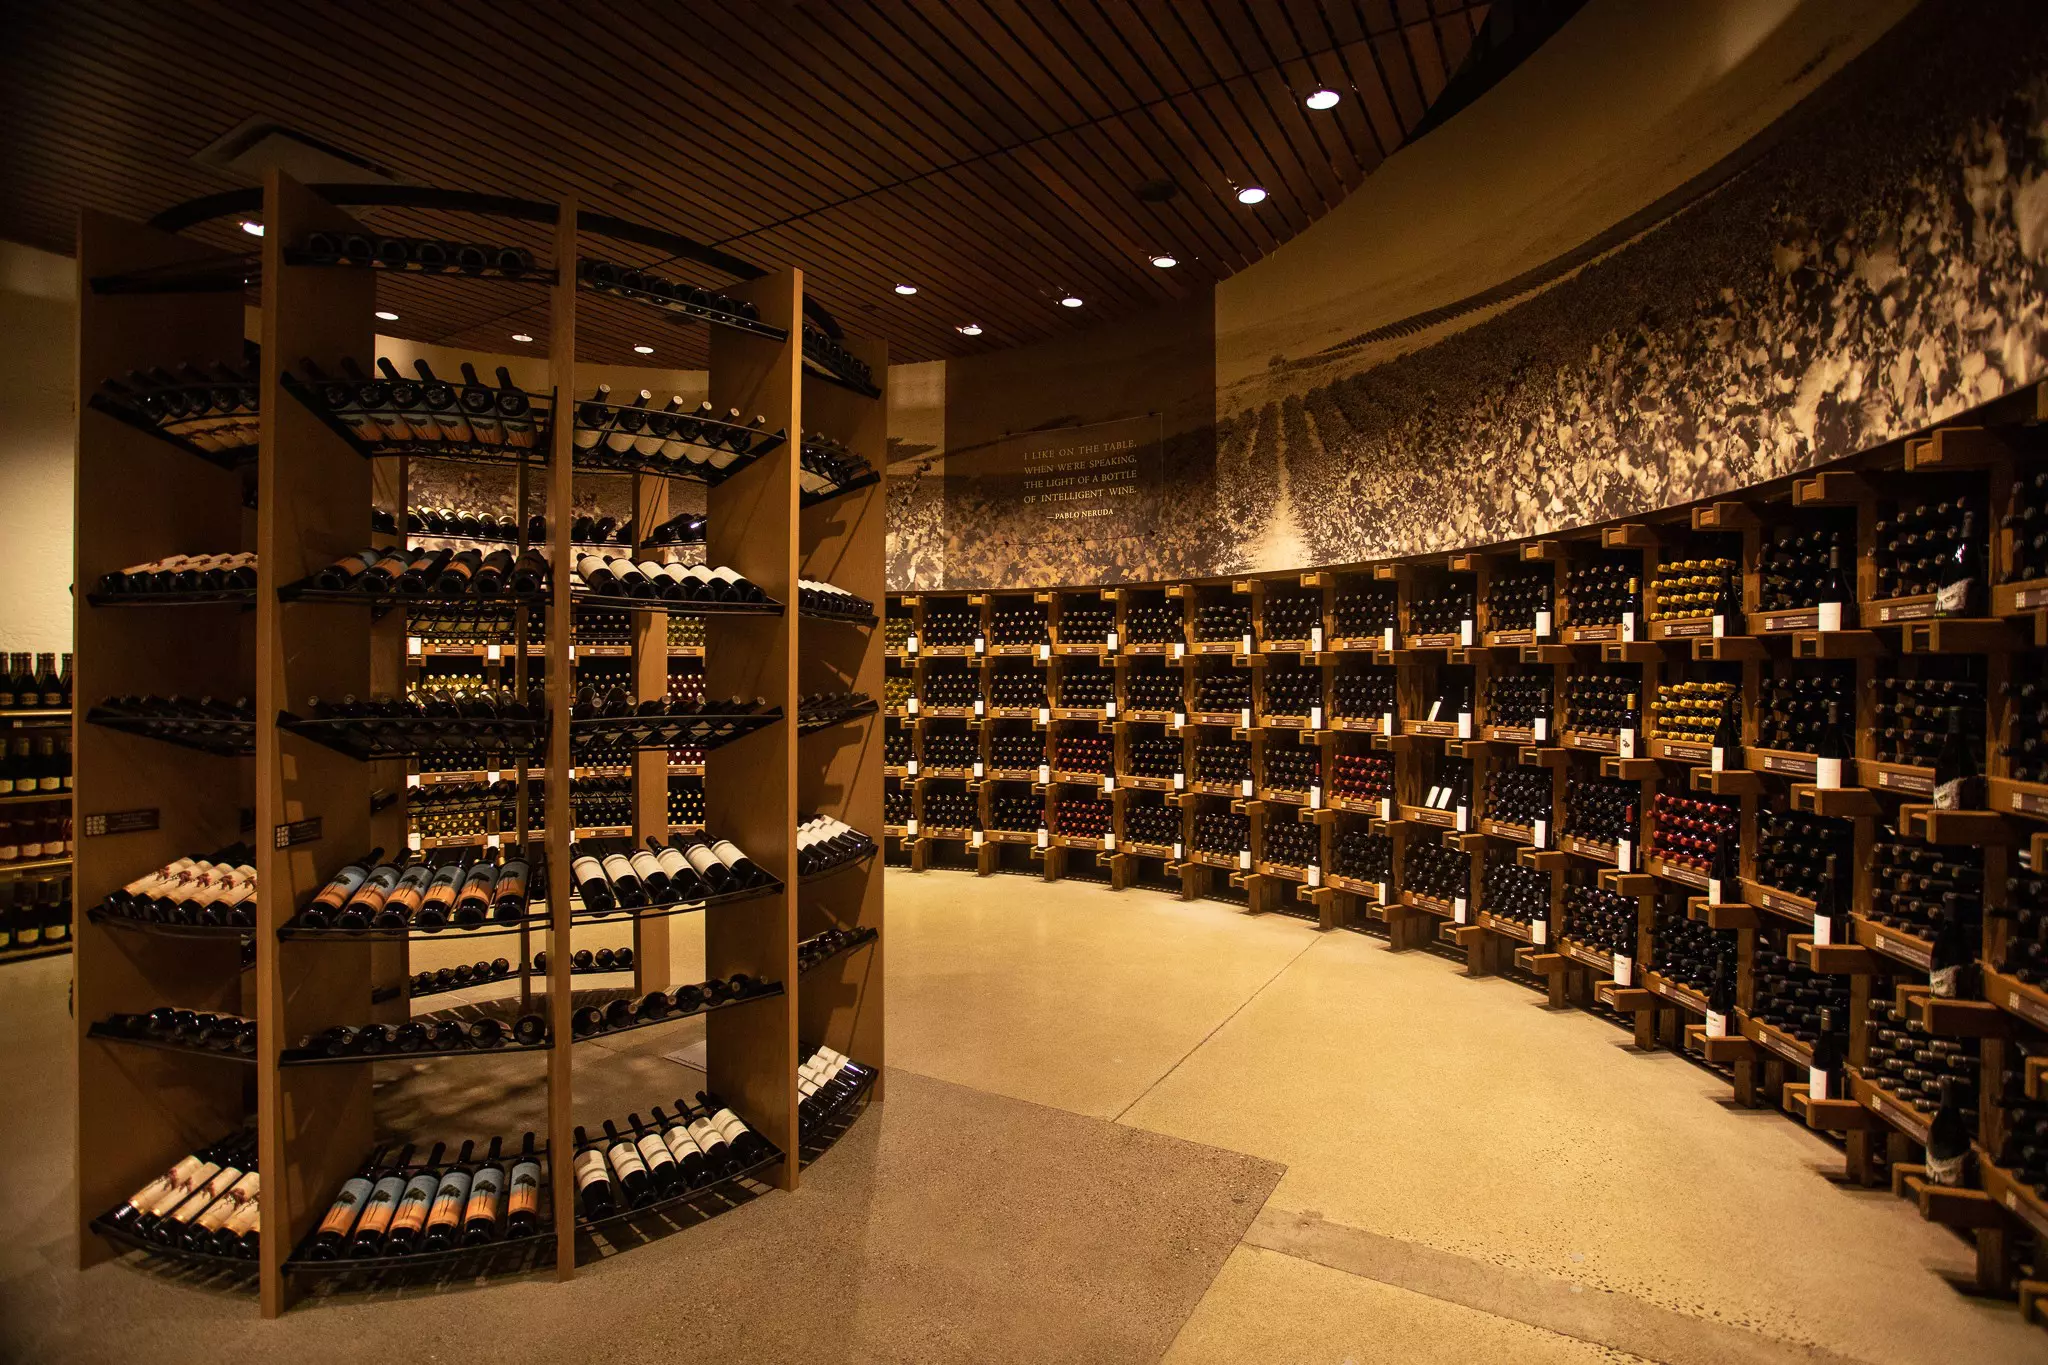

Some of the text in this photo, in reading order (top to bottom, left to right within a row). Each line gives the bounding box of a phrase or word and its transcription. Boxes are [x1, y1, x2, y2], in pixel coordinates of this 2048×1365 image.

[1032, 449, 1054, 459] LIKE
[1059, 448, 1074, 456] ON
[1079, 445, 1099, 454] THE
[1104, 440, 1136, 452] TABLE,
[1024, 455, 1137, 474] WHEN WE'RE SPEAKING,
[1024, 470, 1137, 488] THE LIGHT OF A BOTTLE
[1024, 486, 1136, 504] OF INTELLIGENT WINE.
[1082, 509, 1113, 518] NERUDA
